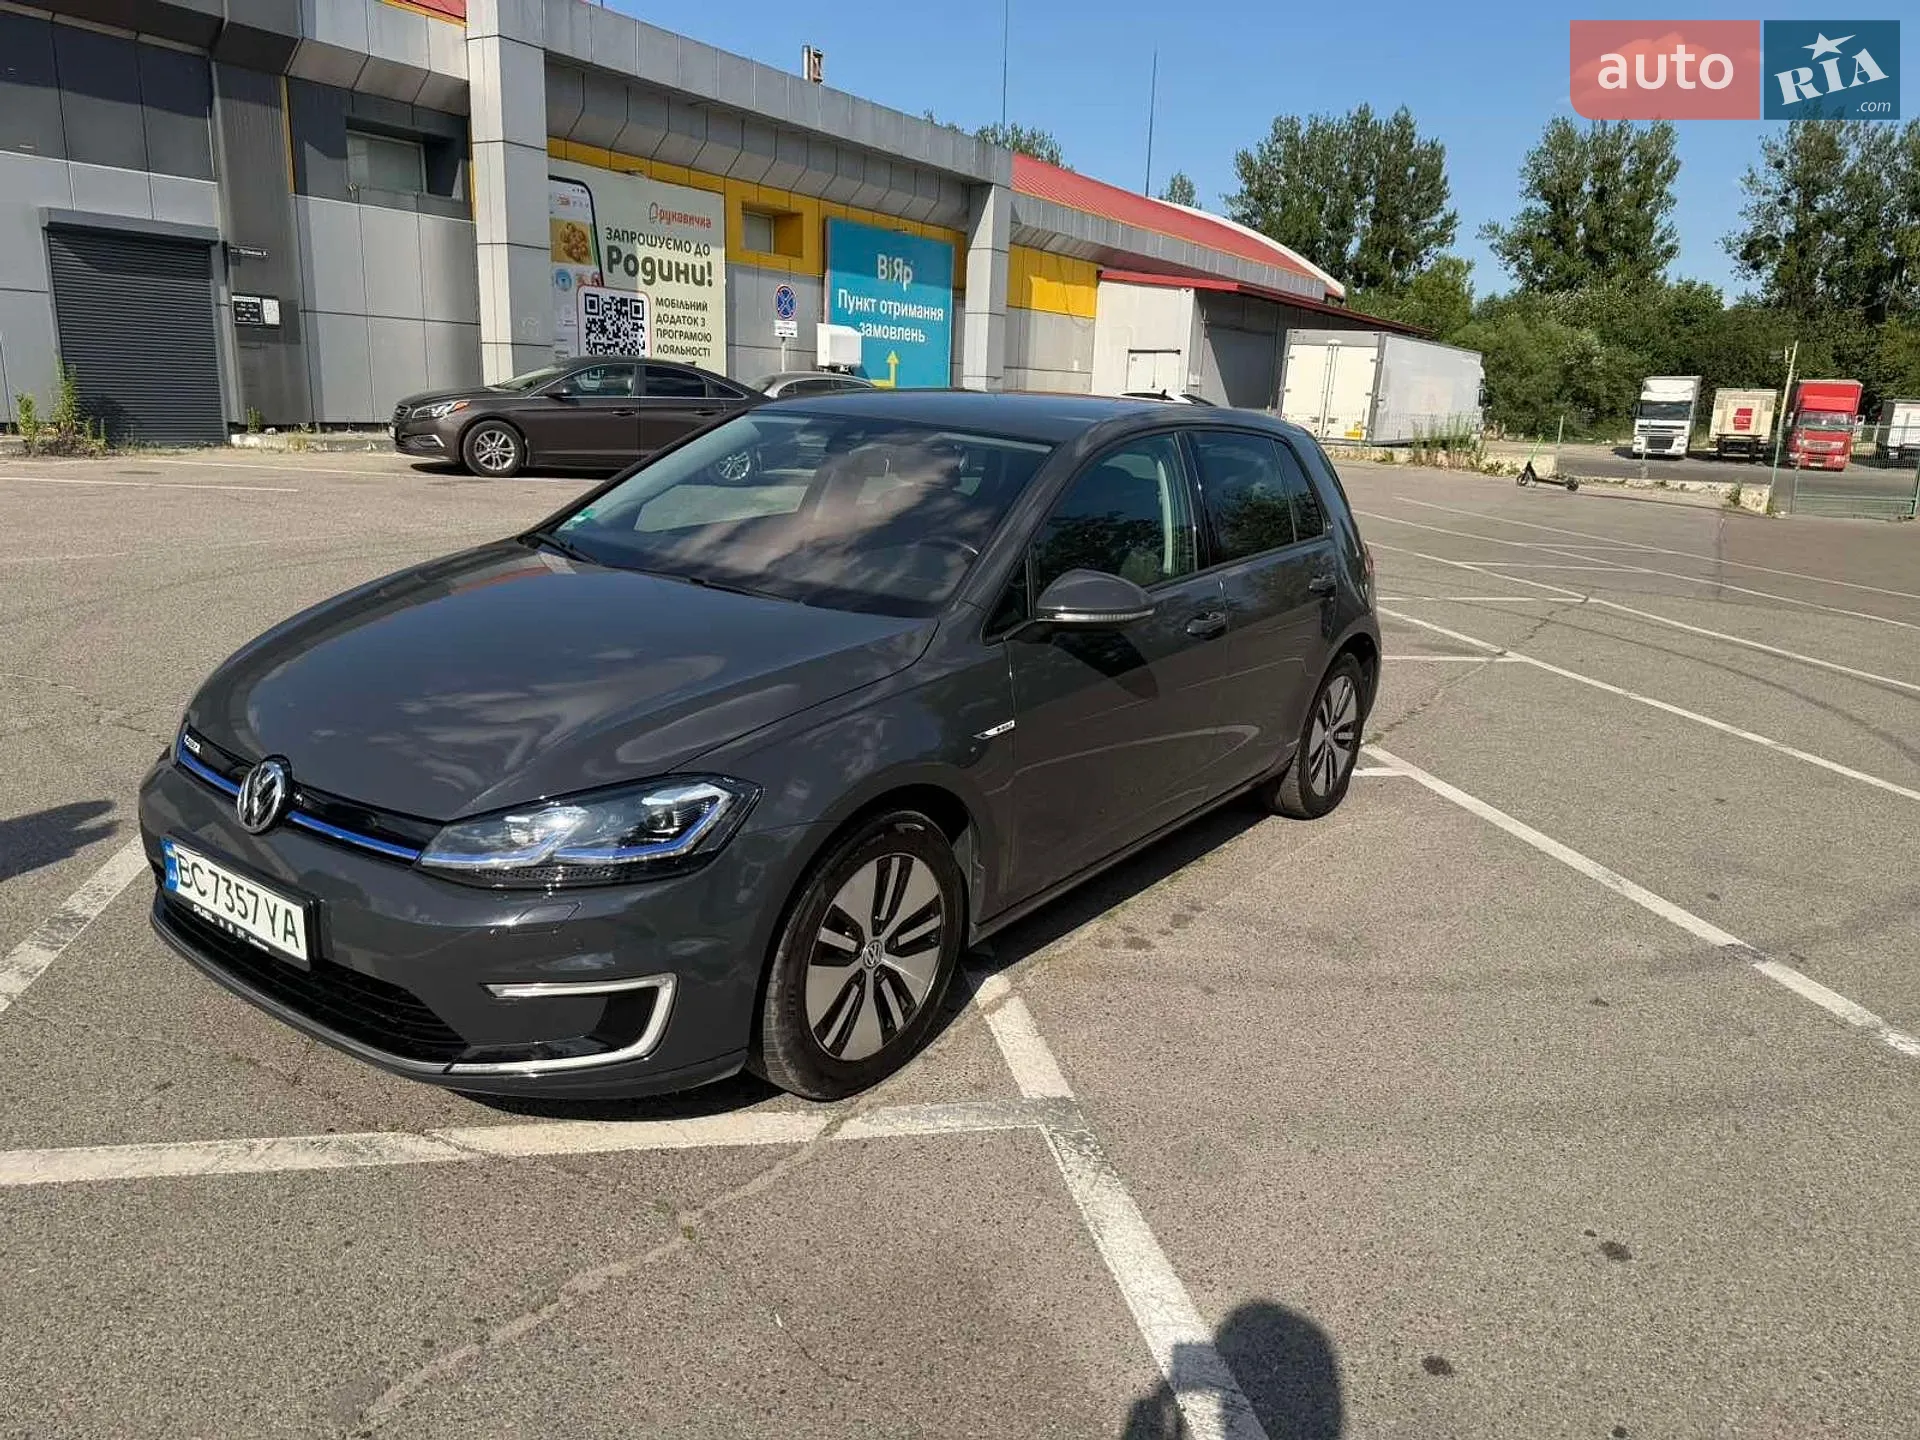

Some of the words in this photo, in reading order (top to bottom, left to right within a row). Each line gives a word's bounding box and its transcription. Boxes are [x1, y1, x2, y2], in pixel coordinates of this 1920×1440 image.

[605, 226, 692, 254] ЗАПРОШУЄМО
[694, 243, 711, 258] ДО
[606, 244, 713, 287] Родини!
[655, 296, 708, 312] МОБІЛЬНИЙ
[838, 288, 877, 315] Пункт
[880, 299, 944, 321] отримання
[656, 312, 699, 327] ДОДАТОК
[656, 327, 712, 343] ПРОГРАМОЮ
[859, 322, 926, 343] замовлень
[656, 343, 711, 358] ЛОЯЛЬНОСТІ
